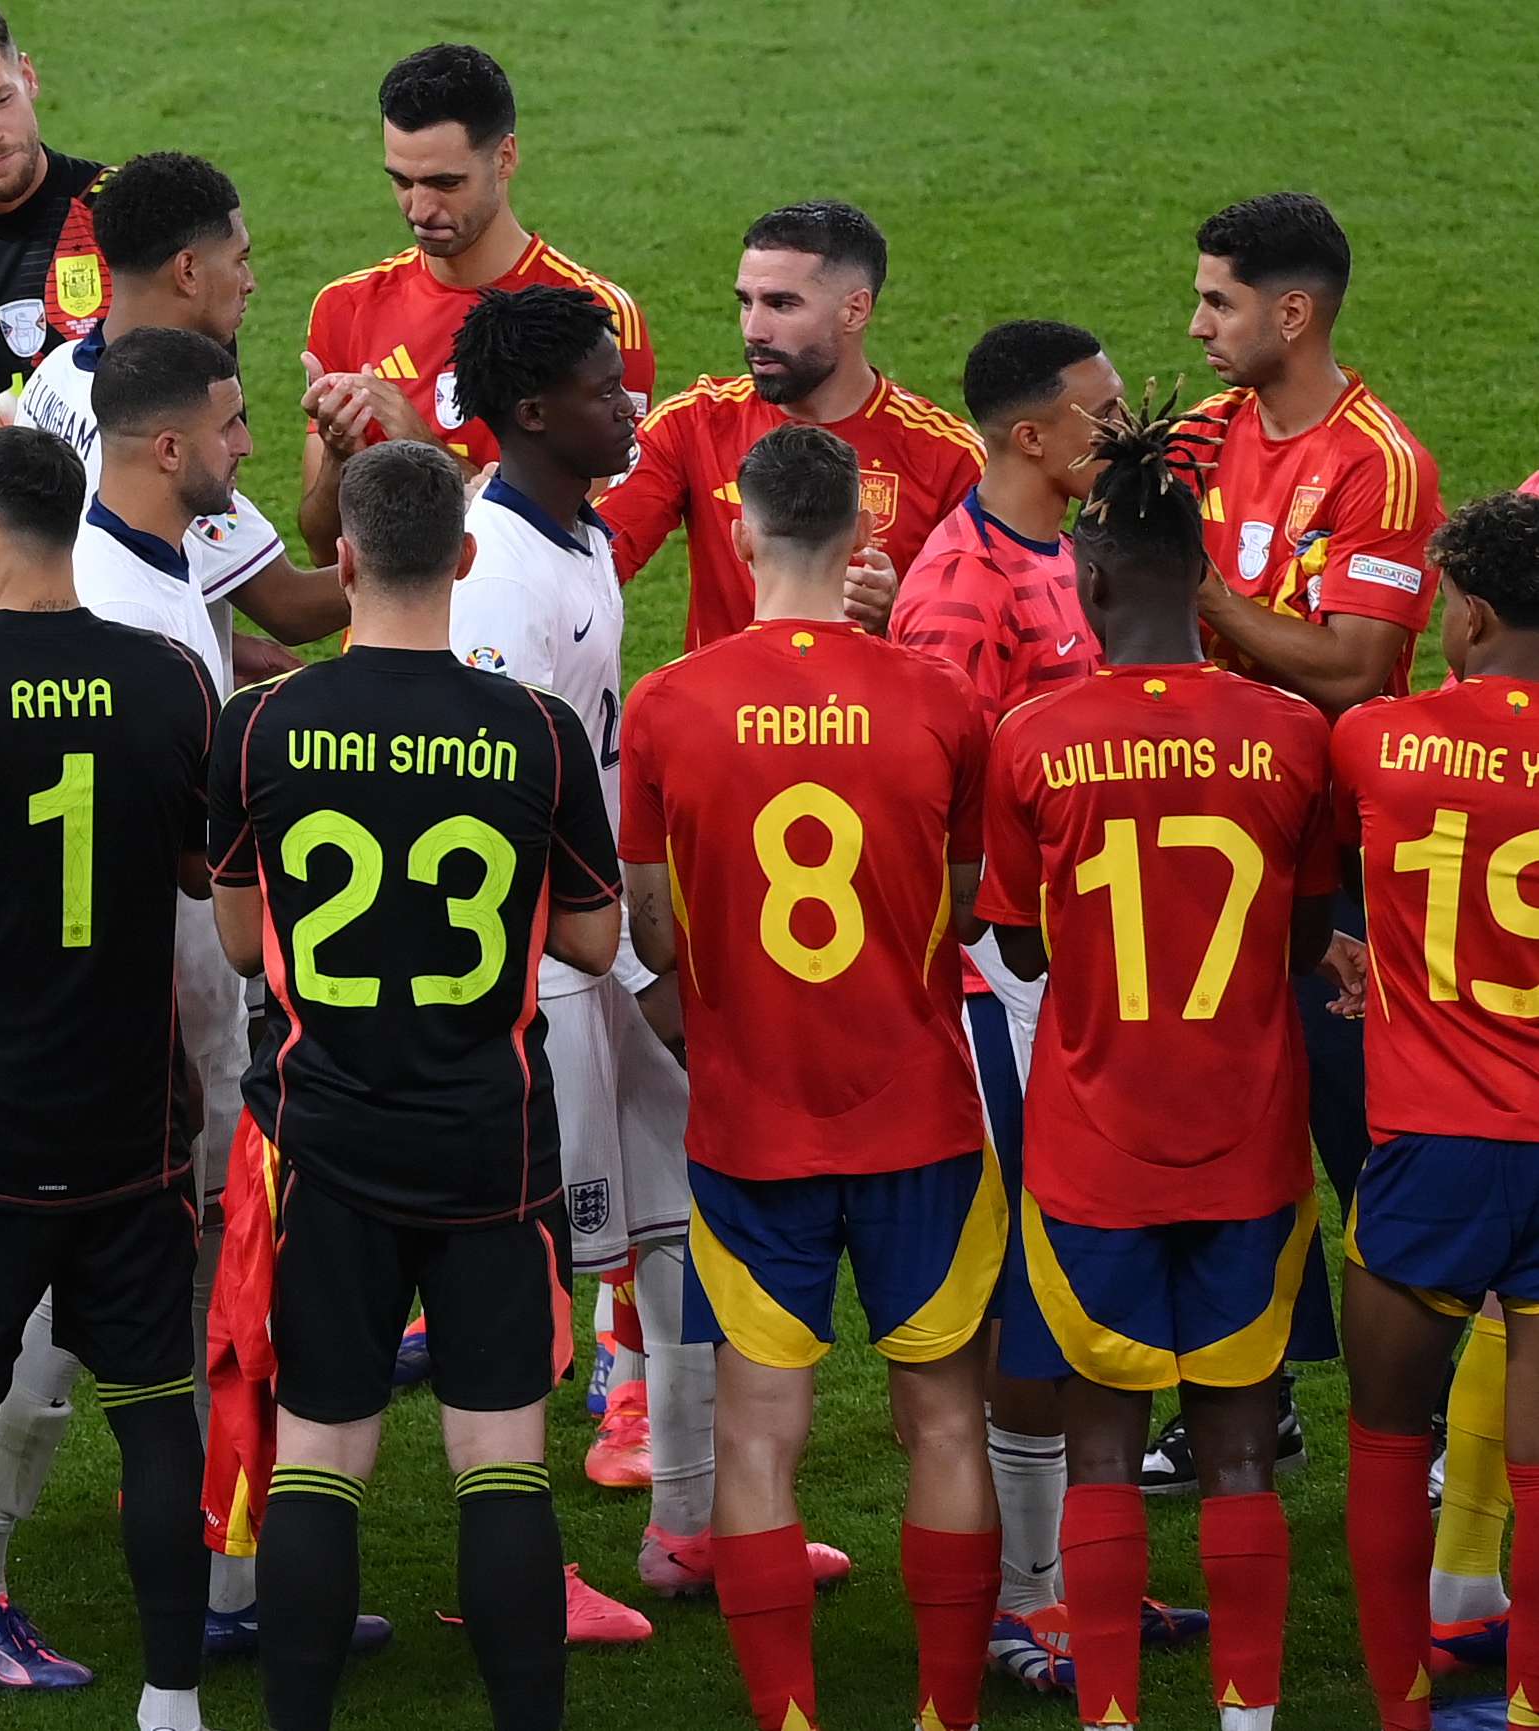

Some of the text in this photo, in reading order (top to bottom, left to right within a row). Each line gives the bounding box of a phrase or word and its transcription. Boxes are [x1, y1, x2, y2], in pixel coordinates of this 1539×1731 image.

[1351, 561, 1419, 586] FOUNDATION
[11, 677, 114, 719] RAYA
[736, 692, 871, 746] FABIÁN
[288, 726, 518, 783] UNAI SIMÓN
[1040, 737, 1282, 790] WILLIAMS JR.
[1379, 731, 1508, 784] LAMINE
[27, 752, 96, 949] 1
[279, 808, 518, 1009] 23
[753, 781, 866, 984] 8
[1075, 814, 1265, 1022] 17
[1393, 808, 1539, 1019] 19
